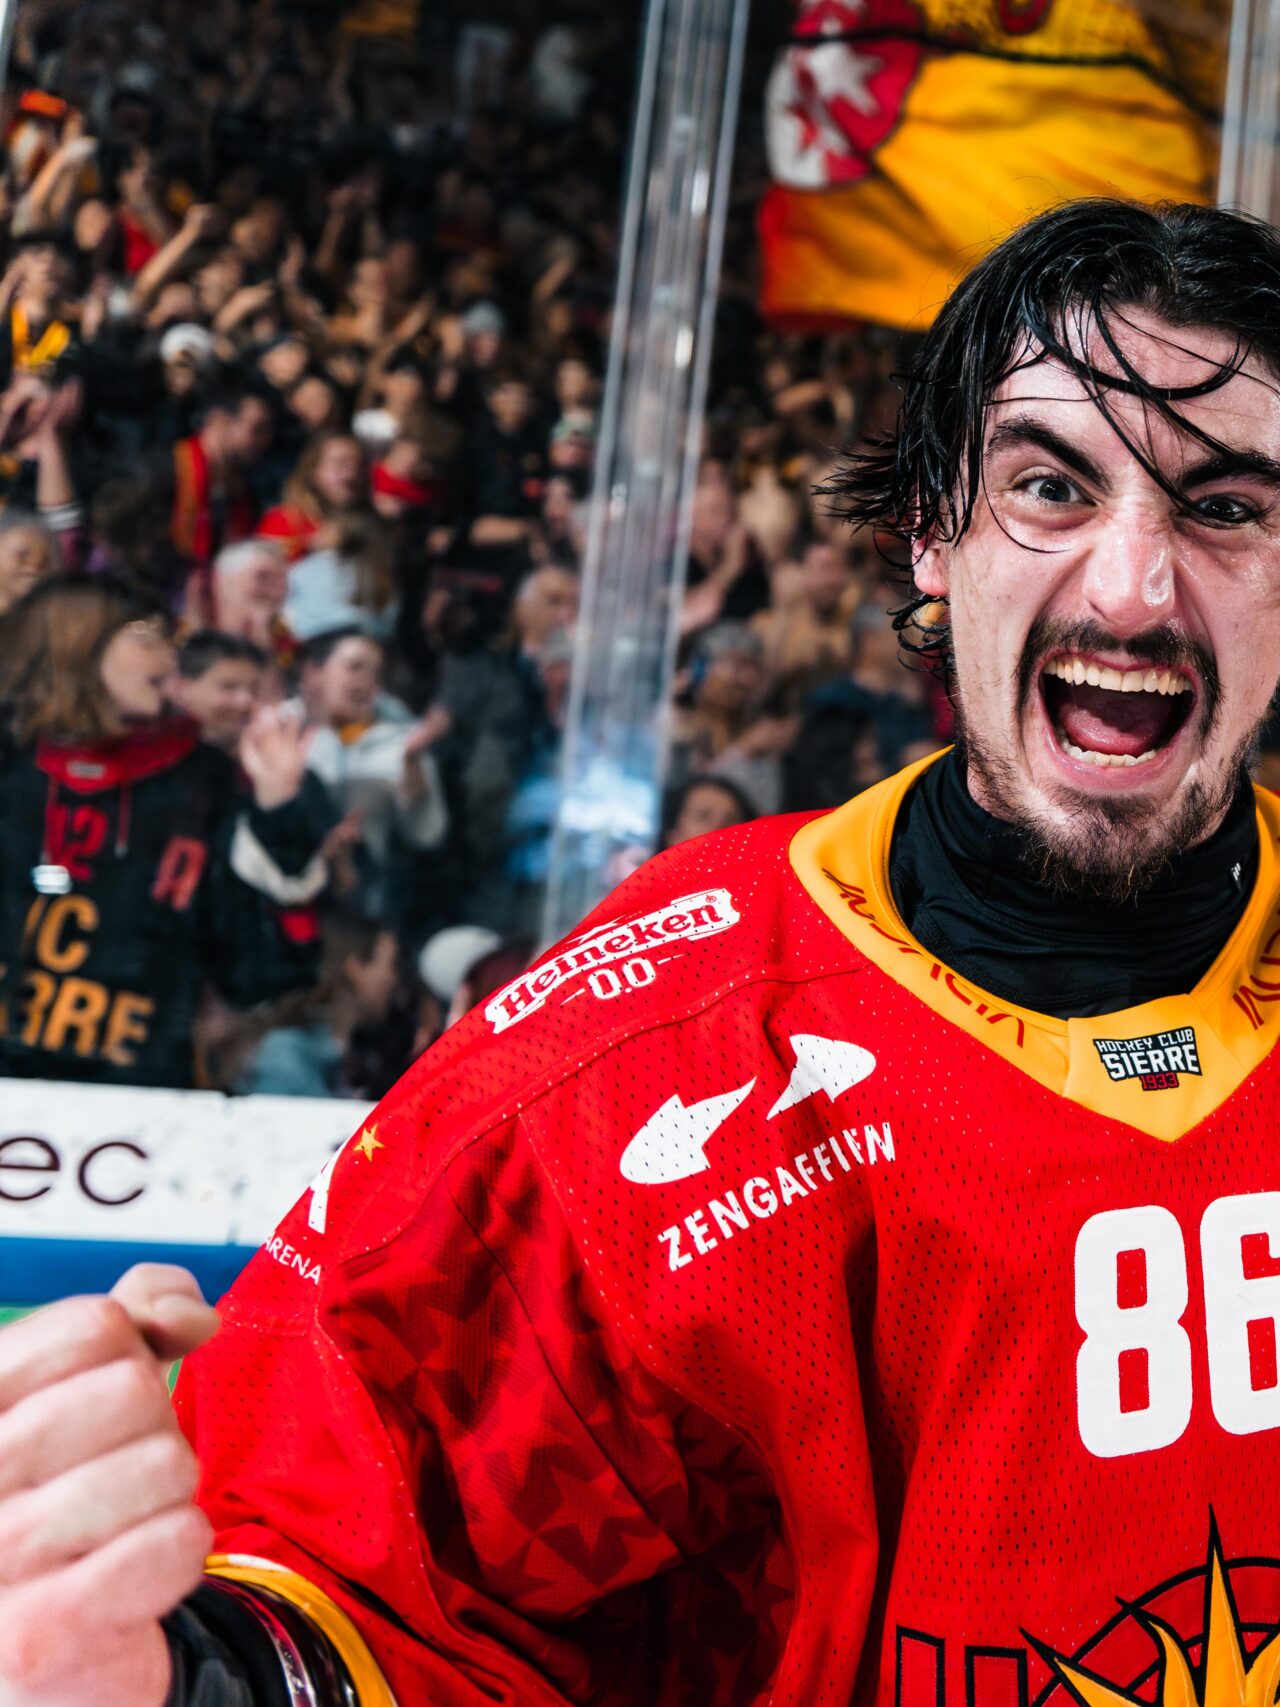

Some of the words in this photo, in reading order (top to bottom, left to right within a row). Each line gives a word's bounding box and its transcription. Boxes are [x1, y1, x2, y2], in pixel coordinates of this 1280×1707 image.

[492, 898, 725, 1024] Heineken
[1095, 1037, 1153, 1053] HOCKEY
[1158, 1028, 1194, 1047] CLUB
[1102, 1043, 1200, 1080] SIERRE
[1140, 1071, 1178, 1090] 1933
